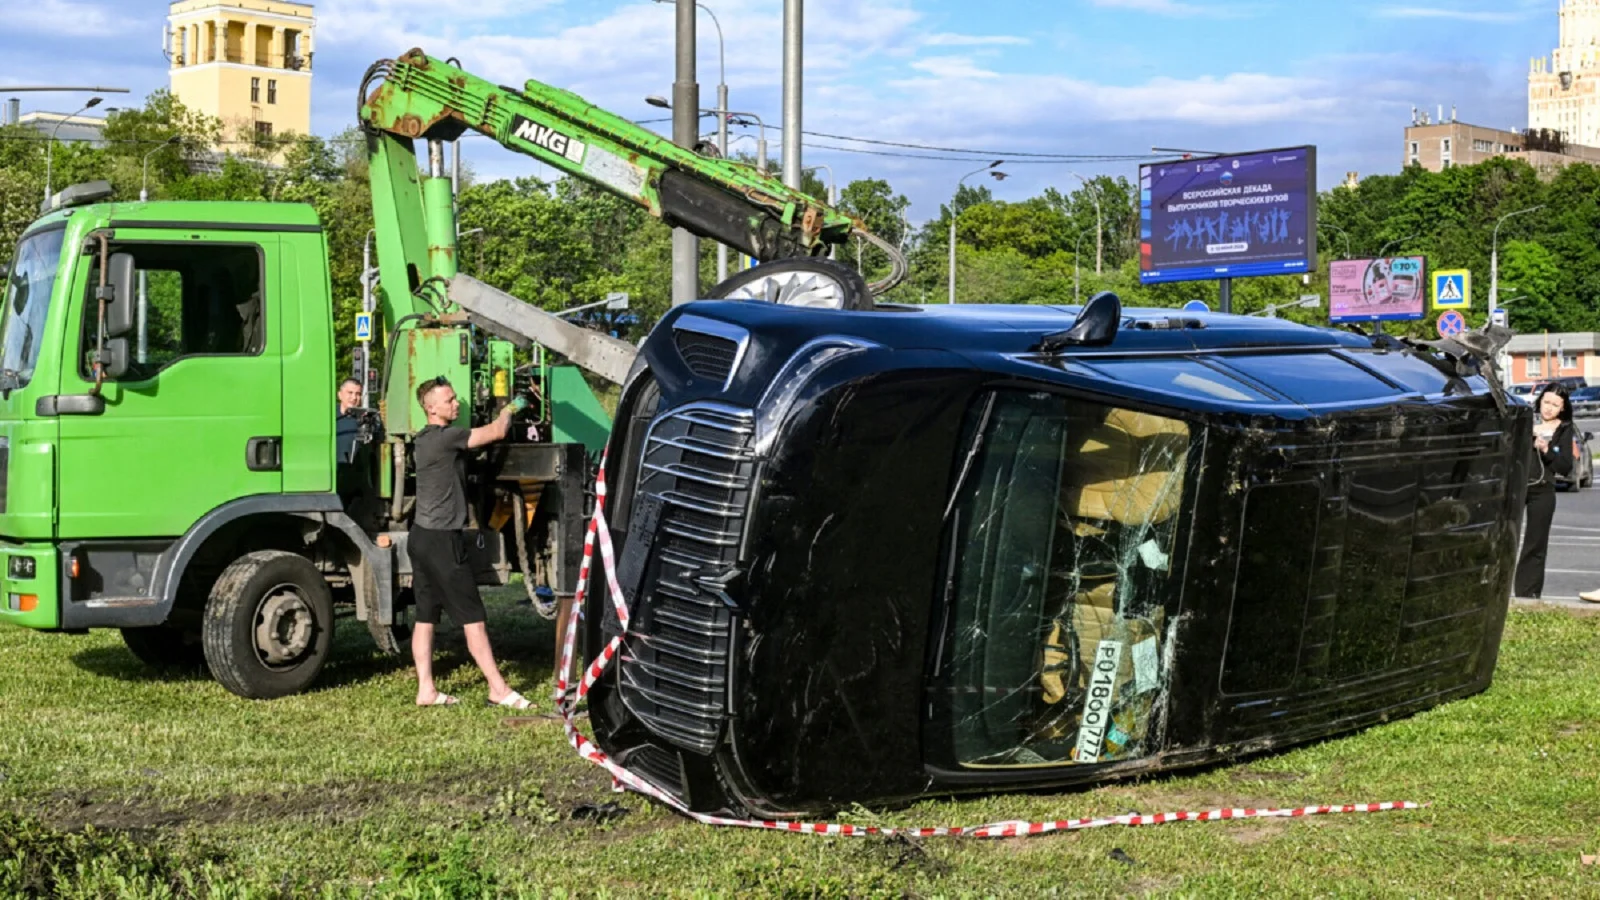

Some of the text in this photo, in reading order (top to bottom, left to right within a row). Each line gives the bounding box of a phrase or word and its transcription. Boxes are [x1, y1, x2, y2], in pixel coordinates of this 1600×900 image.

[514, 120, 567, 156] MKG
[1167, 193, 1289, 212] ВЫПУСКНИКОВ ТВОРЧЕСКИХ ВУЗОВ
[1183, 184, 1272, 200] ВСЕРОССИЙСКАЯ ДЕКАДА
[1084, 728, 1103, 758] 777
